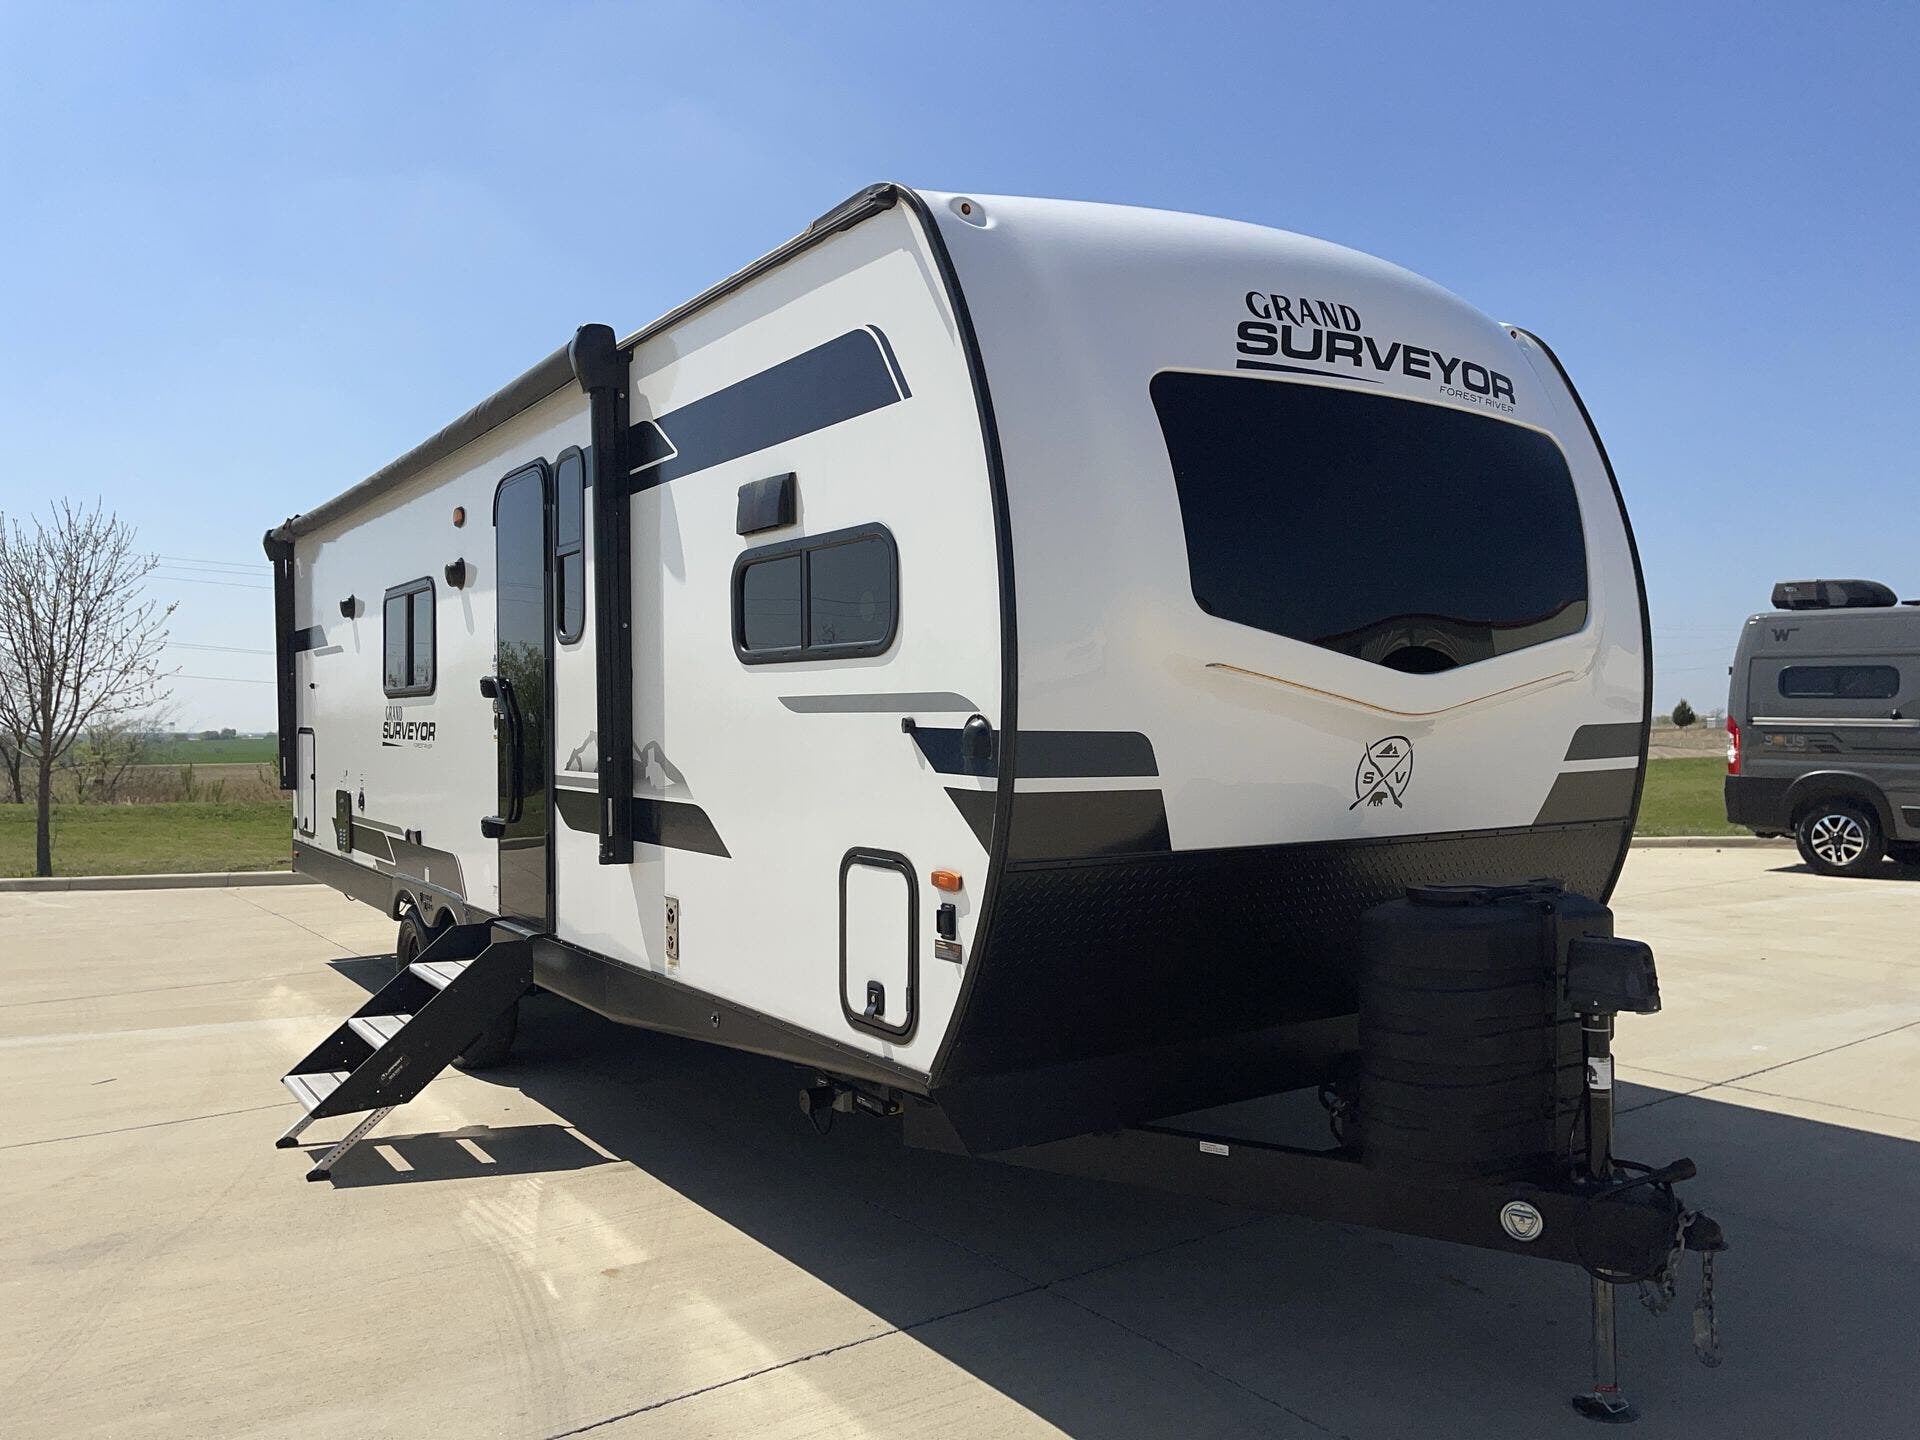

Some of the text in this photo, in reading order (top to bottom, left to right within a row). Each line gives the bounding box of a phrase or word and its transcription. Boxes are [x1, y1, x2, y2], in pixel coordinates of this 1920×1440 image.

[1245, 291, 1361, 332] GRAND
[1236, 320, 1516, 405] SURVEYOR
[1439, 385, 1514, 413] FOREST RIVER
[382, 721, 436, 741] SURVEYOR
[1363, 771, 1407, 784] S V
